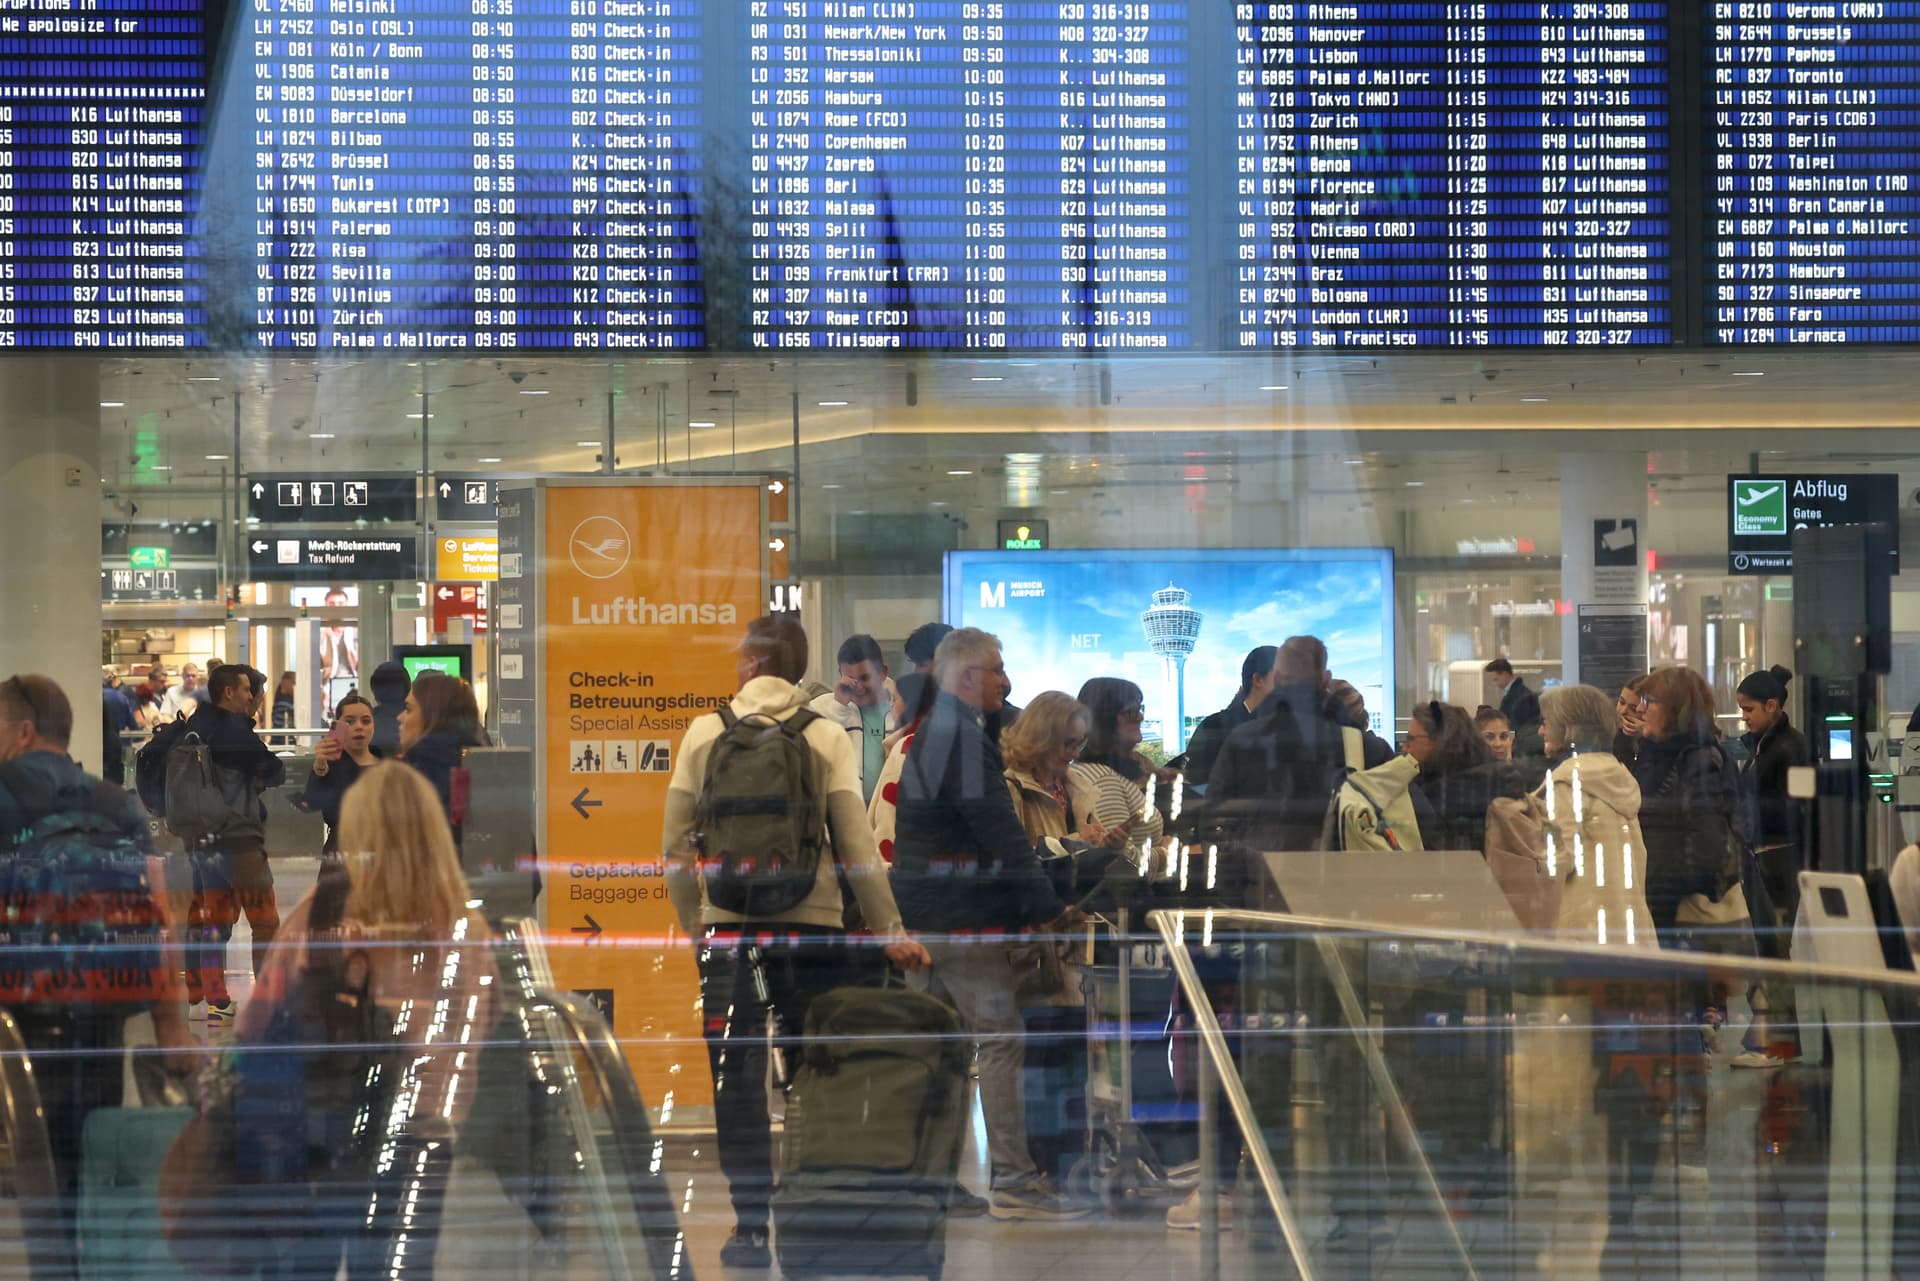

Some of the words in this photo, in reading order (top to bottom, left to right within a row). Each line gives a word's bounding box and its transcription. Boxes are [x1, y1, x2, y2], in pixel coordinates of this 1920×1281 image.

[329, 0, 396, 14] Helsinki
[824, 2, 866, 18] Milan
[1309, 4, 1358, 20] Athens
[1787, 3, 1835, 19] Verona
[2, 17, 20, 32] We
[28, 17, 105, 33] apologize
[114, 18, 138, 33] for
[254, 19, 272, 34] LH
[279, 19, 314, 35] 2452
[330, 19, 364, 36] Oslo
[471, 21, 514, 37] 08:40
[604, 22, 671, 39] Check-in
[914, 25, 947, 41] York
[1715, 25, 1732, 41] SN
[1739, 25, 1772, 41] 2644
[1787, 24, 1851, 41] Brussels
[1309, 26, 1366, 42] Hanover
[330, 42, 365, 58] Köln
[388, 42, 423, 58] Bonn
[824, 46, 921, 62] Thessaloniki
[962, 47, 1004, 63] 09:50
[1309, 48, 1358, 64] Lisbon
[1447, 47, 1486, 63] 11:15
[1716, 47, 1732, 62] LH
[1740, 46, 1772, 62] 1770
[1787, 46, 1836, 62] Paphos
[330, 63, 390, 80] Catania
[472, 65, 514, 81] 08:50
[571, 66, 597, 82] K16
[604, 66, 671, 83] Check-in
[824, 68, 874, 84] Warsaw
[964, 69, 1004, 85] 10:00
[1092, 70, 1166, 86] Lufthansa
[1309, 70, 1350, 85] Palma
[1787, 68, 1844, 84] Toronto
[330, 85, 413, 102] Düsseldorf
[751, 89, 769, 105] LH
[775, 89, 809, 105] 2056
[824, 89, 883, 105] Hamburg
[964, 91, 1004, 106] 10:15
[1310, 92, 1351, 107] Tokyo
[1541, 91, 1566, 106] H24
[1573, 90, 1630, 106] 314-316
[1787, 90, 1828, 105] Milan
[71, 106, 98, 122] K16
[105, 107, 182, 123] Lufthansa
[331, 108, 407, 124] Barcelona
[824, 111, 858, 127] Rome
[1237, 113, 1254, 129] LX
[1263, 113, 1295, 129] 1103
[1310, 113, 1359, 128] Zurich
[1447, 112, 1486, 127] 11:15
[1574, 112, 1646, 127] Lufthansa
[1788, 111, 1828, 126] Paris
[331, 130, 382, 146] Bilbao
[825, 133, 907, 150] Copenhagen
[1310, 135, 1359, 151] Athens
[1788, 133, 1836, 148] Berlin
[331, 152, 389, 169] Brüssel
[825, 155, 875, 172] Zagreb
[1788, 154, 1835, 169] Taipei
[256, 174, 273, 191] LH
[282, 174, 316, 191] 1744
[331, 174, 374, 192] Tunis
[473, 176, 515, 192] 08:55
[605, 176, 672, 193] Check-in
[825, 177, 857, 194] Bari
[1310, 178, 1375, 194] Florence
[1788, 175, 1868, 191] Washington
[72, 196, 99, 212] K14
[106, 196, 183, 213] Lufthansa
[331, 197, 398, 214] Bukarest
[825, 200, 875, 216] Malaga
[965, 200, 1005, 216] 10:35
[1061, 201, 1086, 216] K20
[1093, 201, 1167, 217] Lufthansa
[1310, 200, 1359, 216] Madrid
[1788, 197, 1821, 213] Gran
[1828, 197, 1884, 213] Canaria
[331, 220, 391, 236] Palermo
[825, 222, 866, 238] Split
[1311, 222, 1367, 238] Chicago
[1789, 219, 1829, 235] Palma
[331, 242, 366, 258] Riga
[825, 244, 875, 260] Berlin
[1311, 244, 1360, 259] Vienna
[1789, 241, 1845, 257] Houston
[332, 264, 392, 281] Sevilla
[825, 266, 898, 282] Frankfurt
[1239, 266, 1256, 282] LH
[1263, 266, 1296, 282] 2344
[1311, 266, 1344, 281] Graz
[1449, 265, 1488, 281] 11:40
[1575, 264, 1648, 280] Lufthansa
[1789, 263, 1845, 279] Hamburg
[332, 287, 392, 303] Vilnius
[474, 287, 516, 303] 09:00
[606, 288, 672, 304] Check-in
[825, 288, 868, 304] Malta
[1311, 288, 1368, 303] Bologna
[1789, 285, 1861, 300] Singapore
[332, 309, 384, 325] Zürich
[826, 310, 860, 326] Rome
[966, 310, 1006, 326] 11:00
[1094, 310, 1151, 326] 316-319
[1239, 309, 1257, 325] LH
[1263, 309, 1297, 325] 2474
[1311, 309, 1360, 324] London
[1543, 308, 1568, 323] H35
[1575, 308, 1648, 323] Lufthansa
[1789, 306, 1822, 322] Faro
[332, 332, 375, 347] Palma
[383, 332, 467, 347] d.Mallorca
[475, 332, 517, 347] 09:05
[826, 332, 900, 348] Timisoara
[1312, 330, 1336, 346] San
[1344, 330, 1417, 345] Francisco
[1789, 328, 1846, 343] Larnaca
[1793, 479, 1848, 501] Abflug
[1738, 514, 1778, 525] Economy
[1793, 507, 1822, 520] Gates
[1738, 522, 1762, 531] Class
[1006, 539, 1041, 550] ROLEX
[308, 553, 324, 563] Tax
[325, 553, 355, 564] Refund
[1752, 558, 1785, 567] Wartezeit
[1010, 581, 1043, 589] MUNICH
[980, 581, 1006, 609] M
[1010, 589, 1046, 598] AIRPORT
[571, 596, 737, 625] Lufthansa
[1070, 633, 1102, 649] NET
[569, 671, 655, 688] Check-in
[570, 714, 634, 734] Special
[570, 884, 649, 904] Baggage
